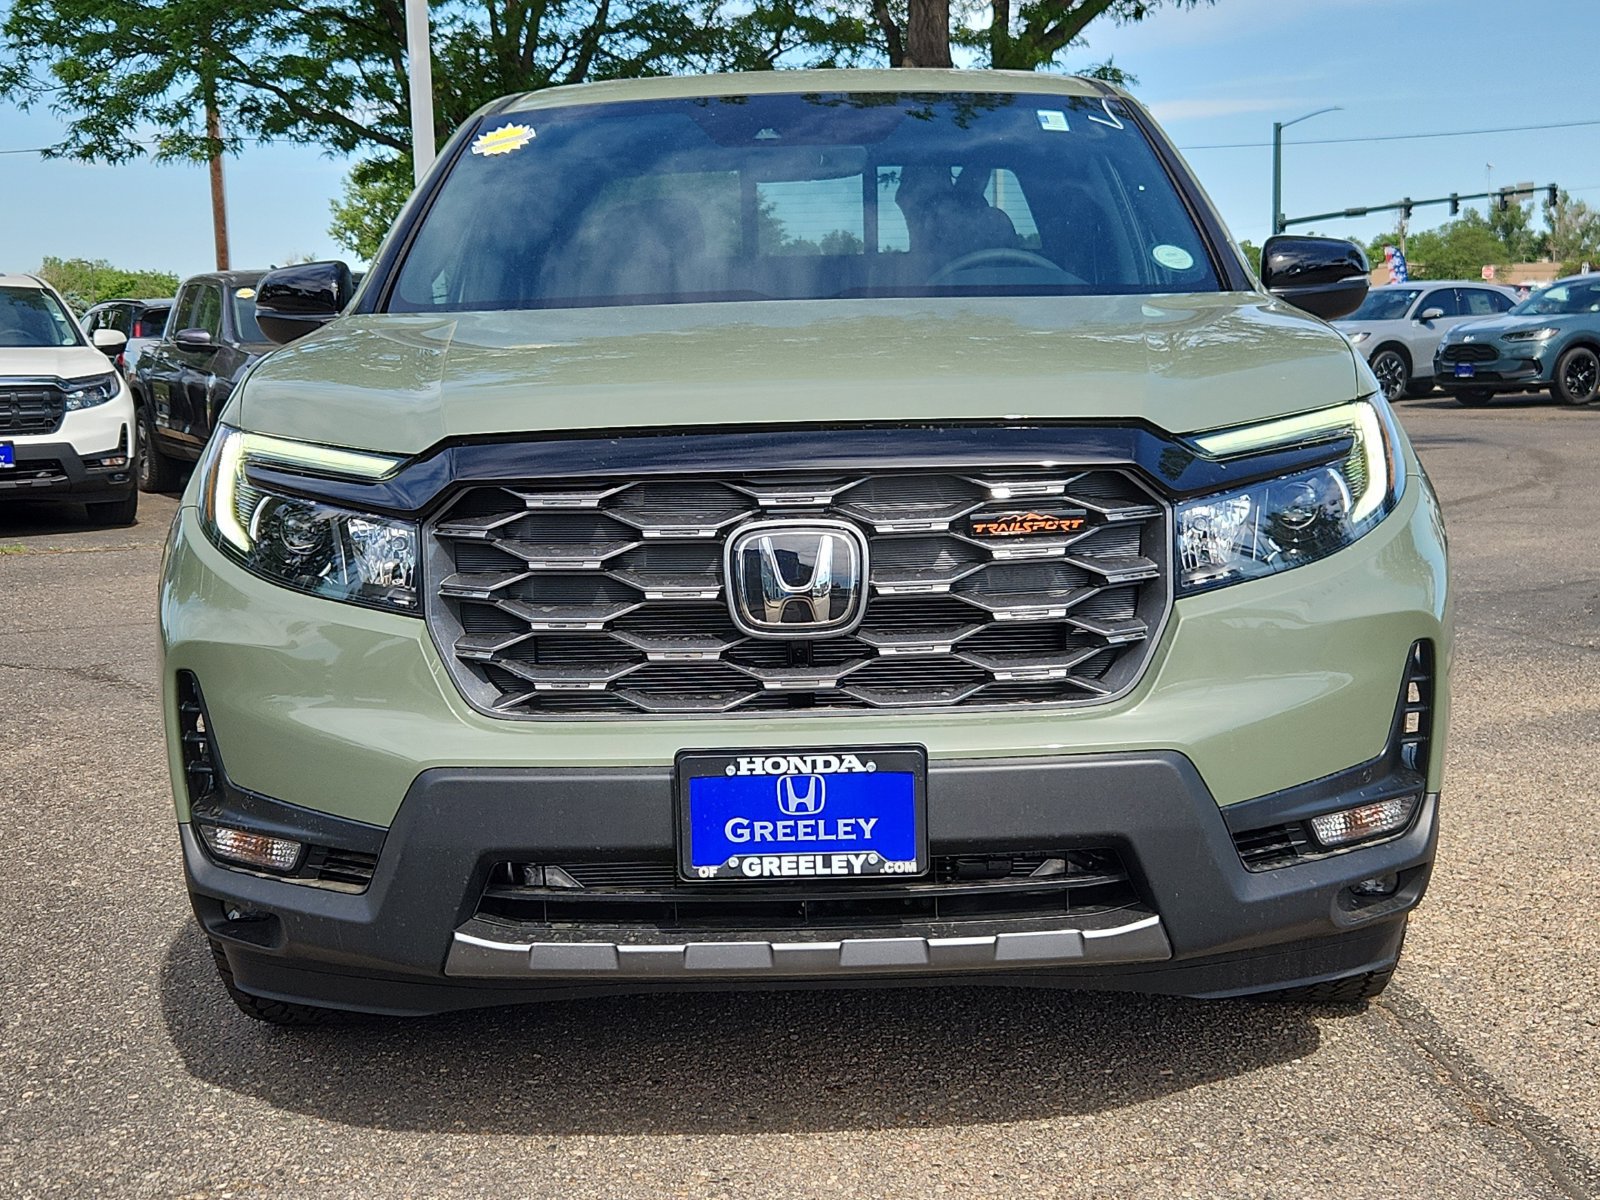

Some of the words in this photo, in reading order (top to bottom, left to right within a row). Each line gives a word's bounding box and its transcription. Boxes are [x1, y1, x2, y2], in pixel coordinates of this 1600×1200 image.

[972, 519, 1084, 534] TRAILSPORT
[736, 754, 868, 776] HONDA
[724, 817, 879, 843] GREELEY
[698, 866, 718, 878] OF
[742, 854, 867, 877] GREELEY
[880, 861, 917, 874] .COM
